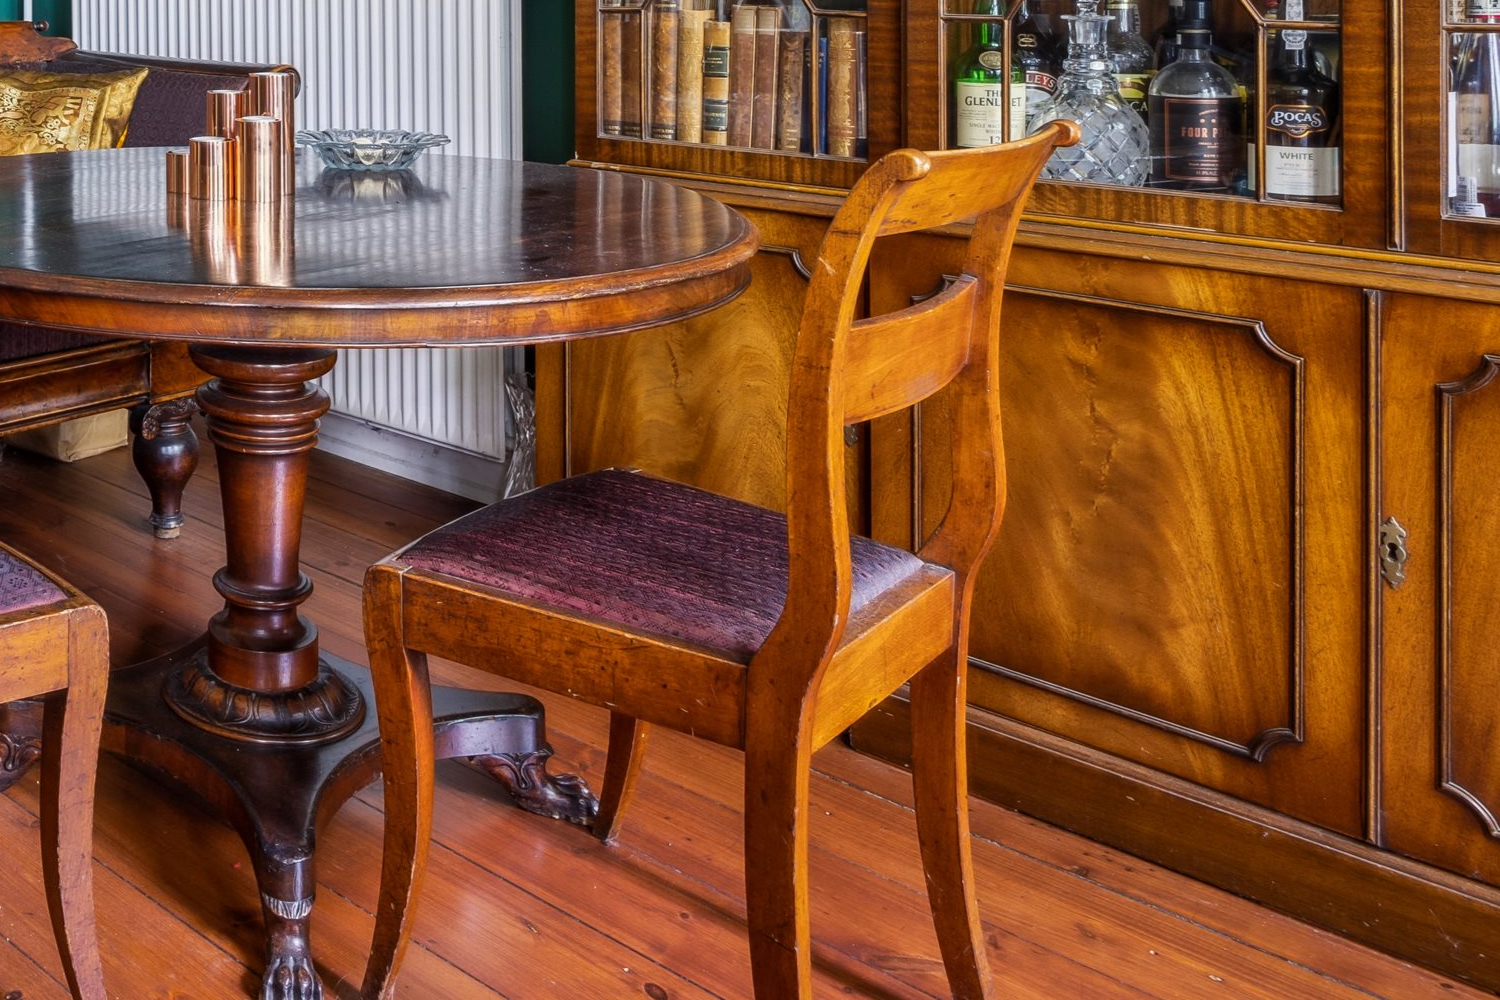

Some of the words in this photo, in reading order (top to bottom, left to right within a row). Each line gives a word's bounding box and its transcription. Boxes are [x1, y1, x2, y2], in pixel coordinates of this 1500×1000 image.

[1271, 110, 1322, 128] POÇAS
[1181, 126, 1208, 138] FOUR
[1279, 151, 1314, 161] WHITE
